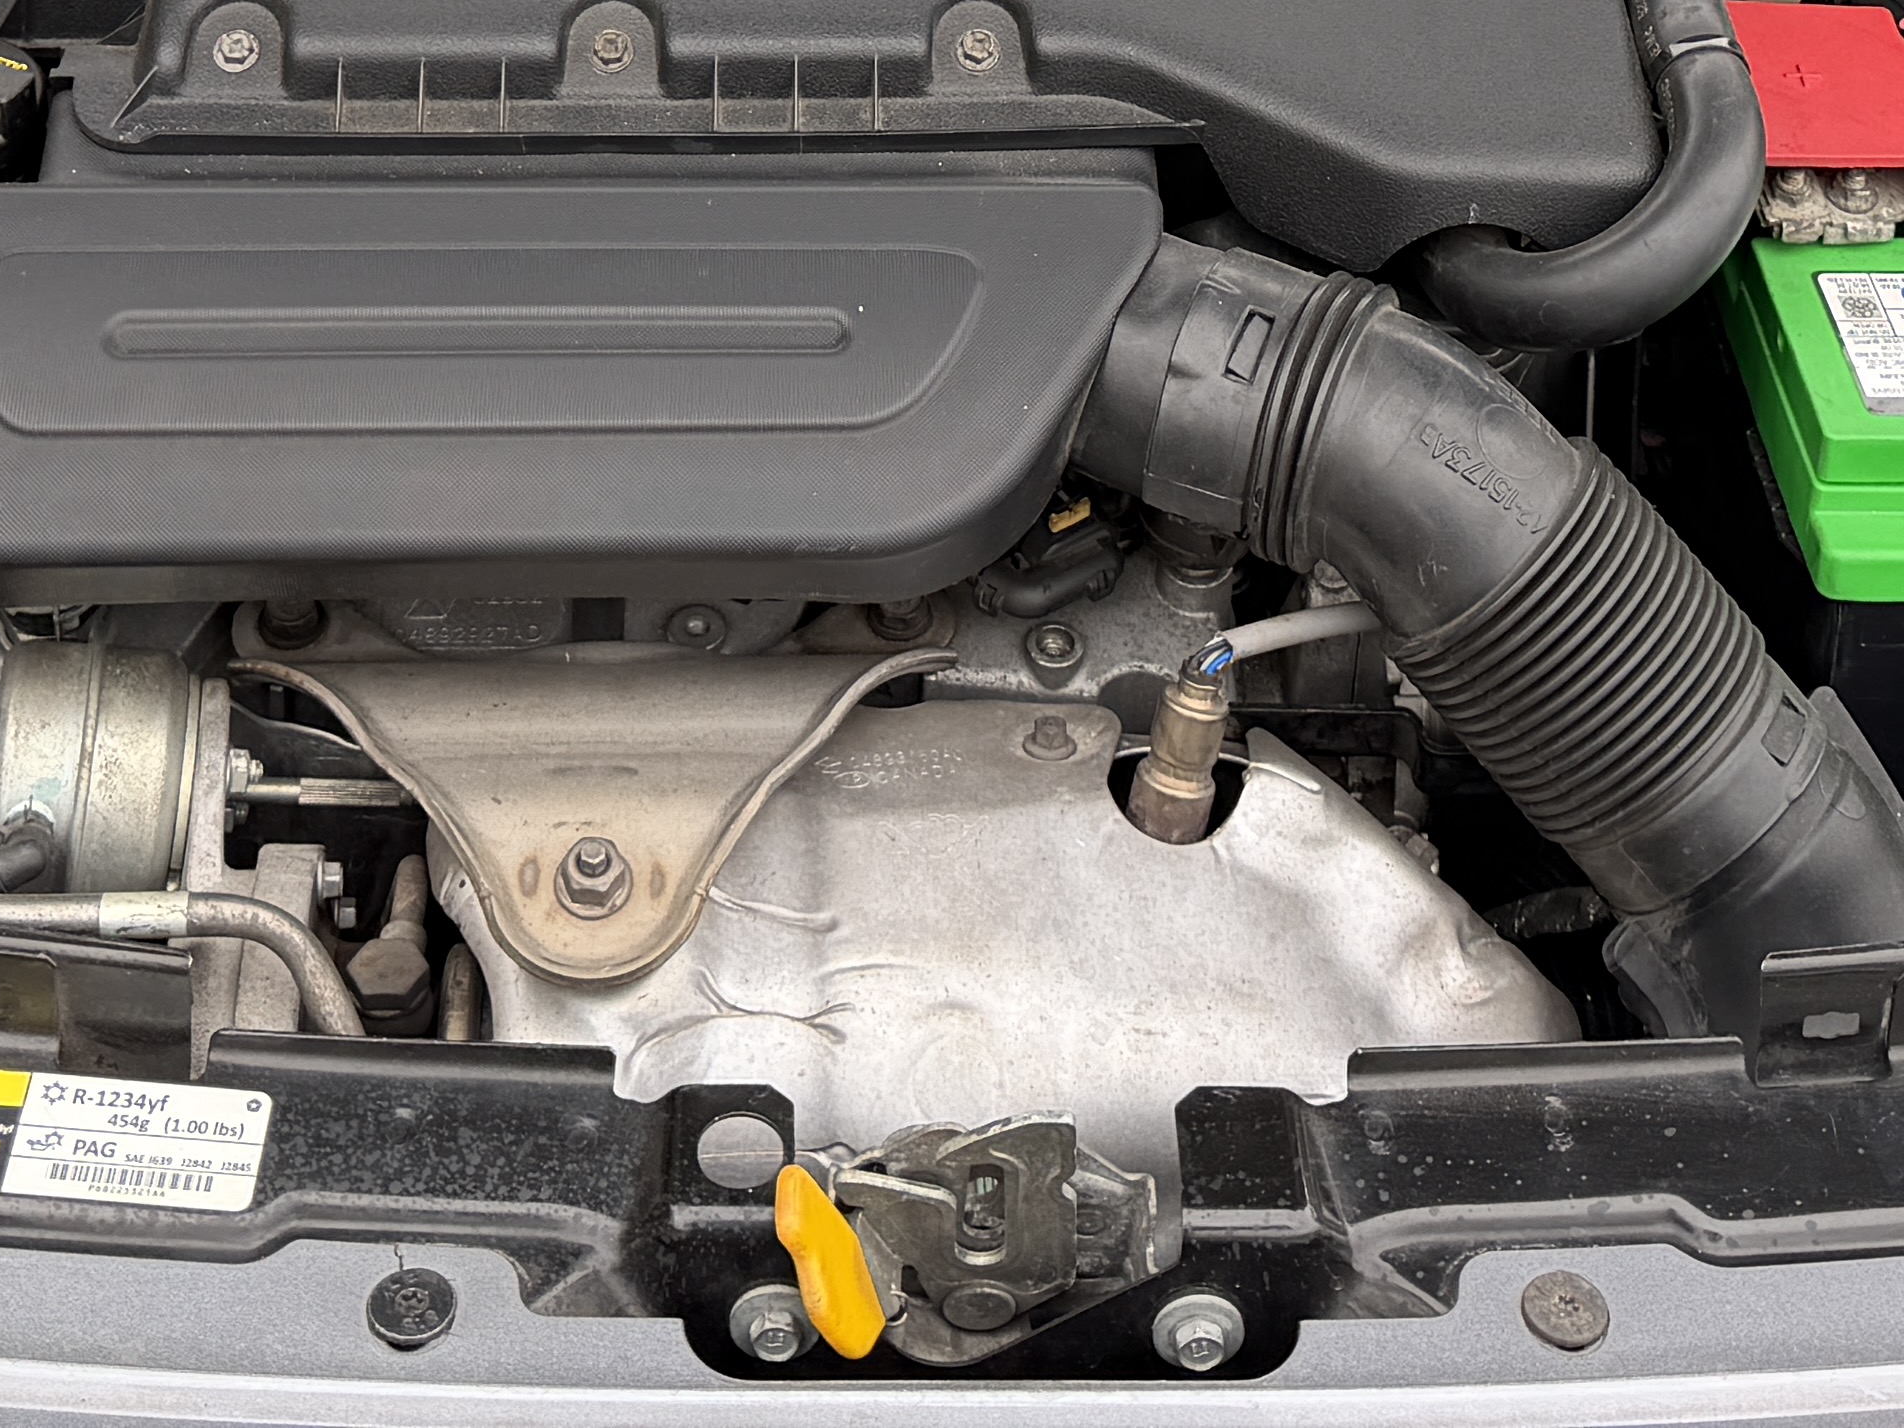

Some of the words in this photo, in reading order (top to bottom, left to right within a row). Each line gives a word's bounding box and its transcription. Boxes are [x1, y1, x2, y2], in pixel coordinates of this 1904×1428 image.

[72, 1088, 171, 1115] R-1234yf
[107, 1113, 151, 1133] 454g
[163, 1116, 209, 1135] (1.00
[213, 1121, 245, 1140] lbs)
[72, 1139, 118, 1159] PAG
[124, 1153, 145, 1164] SAE
